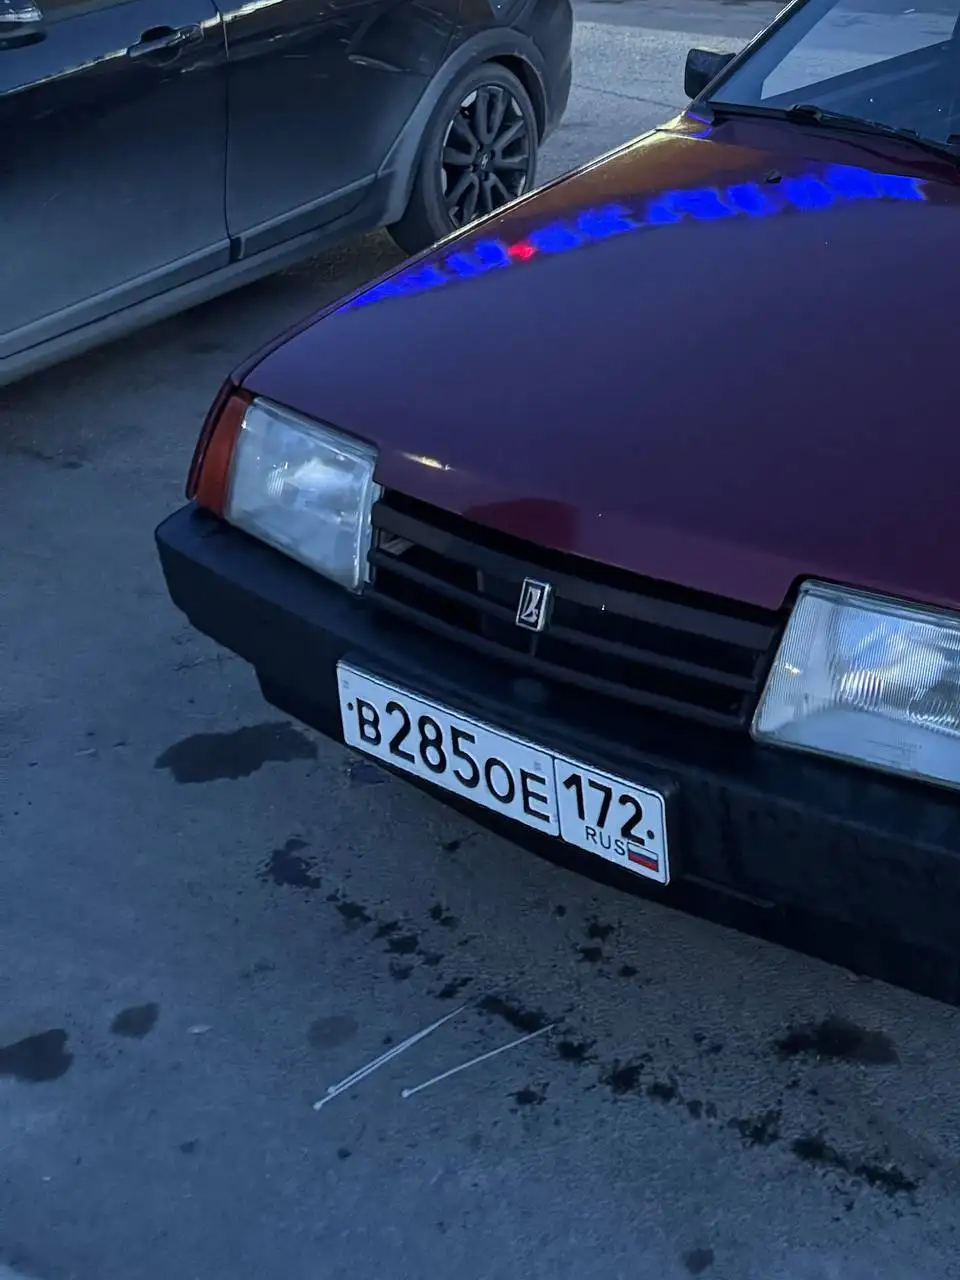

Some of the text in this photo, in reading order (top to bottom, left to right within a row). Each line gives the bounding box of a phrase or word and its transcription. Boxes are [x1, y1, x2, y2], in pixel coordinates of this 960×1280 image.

[355, 697, 647, 846] В285ОЕ 172
[584, 826, 626, 857] RUS
